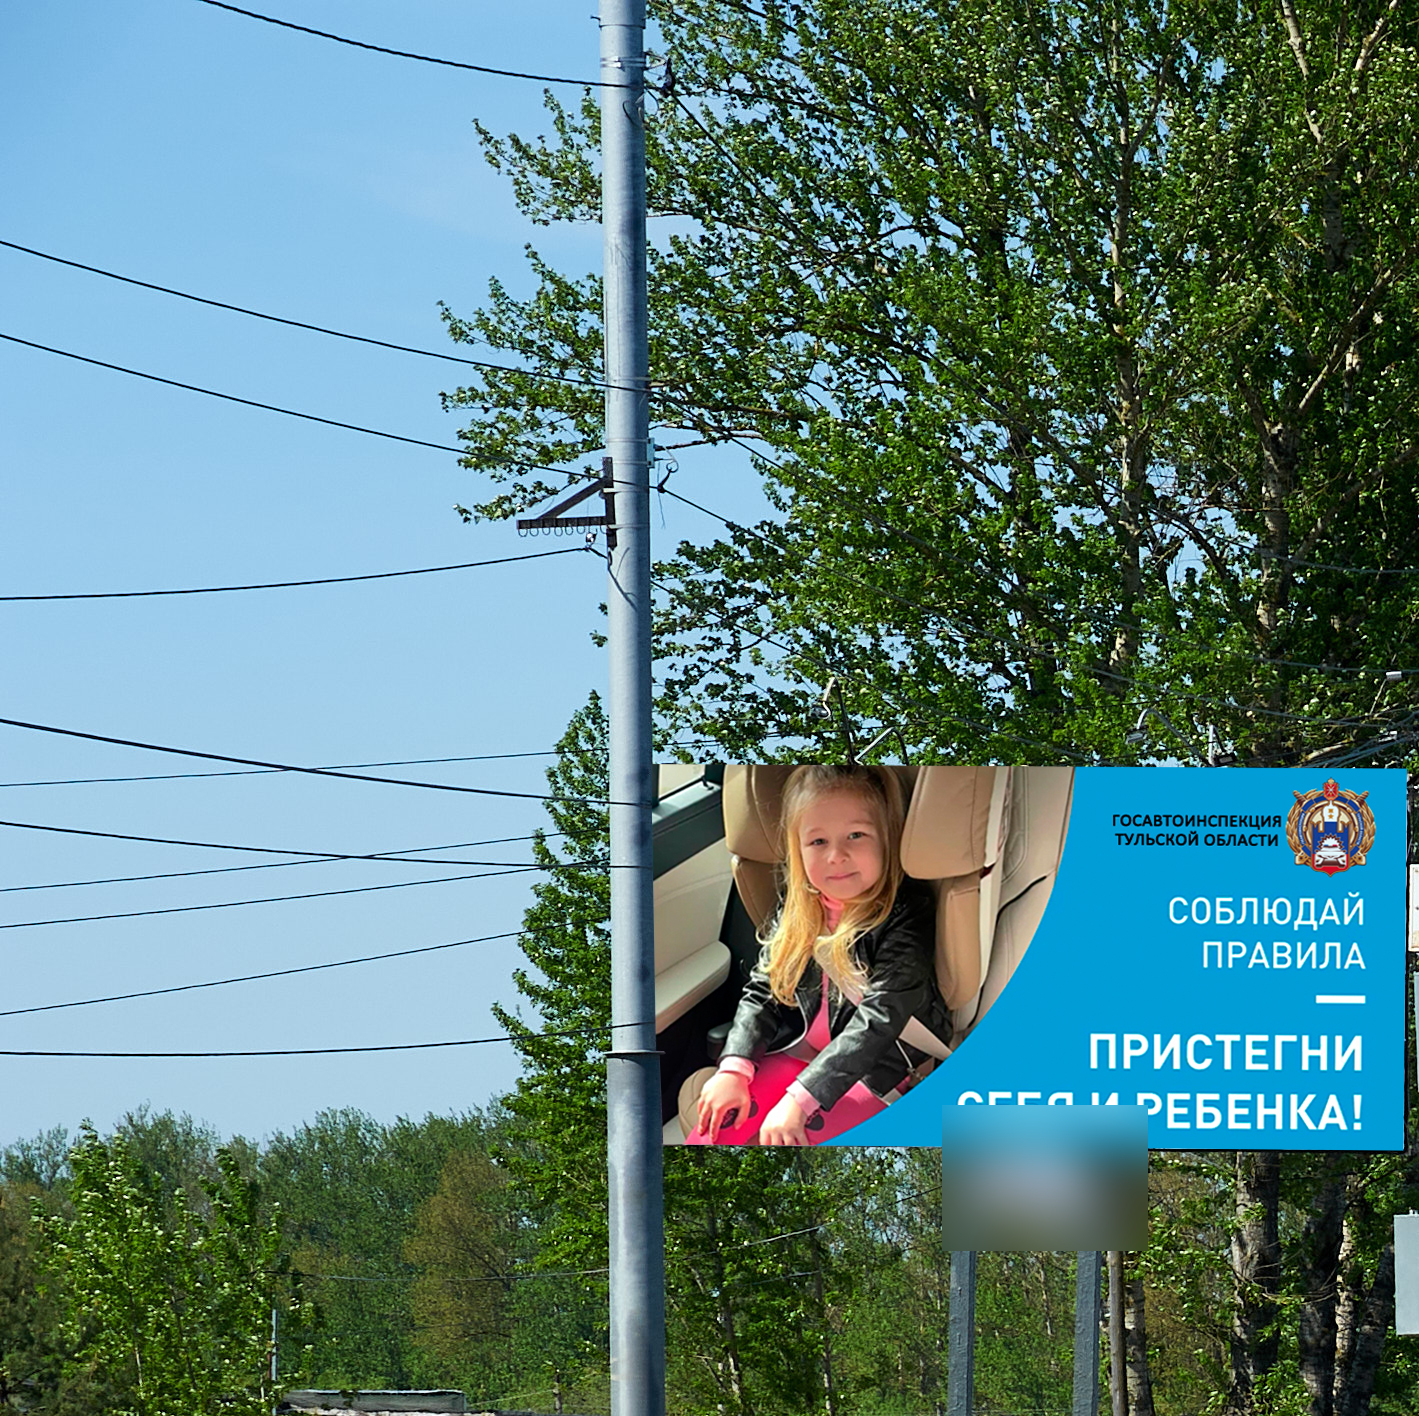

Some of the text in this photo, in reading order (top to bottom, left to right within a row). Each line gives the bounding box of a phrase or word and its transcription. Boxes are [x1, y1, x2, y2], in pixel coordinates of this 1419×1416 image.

[1112, 814, 1282, 830] ГОСАВТОИНСПЕКЦИЯ
[1115, 831, 1279, 848] ТУЛЬСКОЙ ОБЛАСТИ
[1168, 891, 1365, 931] СОБЛЮДАЙ
[1202, 941, 1366, 970] ПРАВИЛА
[1089, 1033, 1363, 1072] ПРИСТЕГНИ
